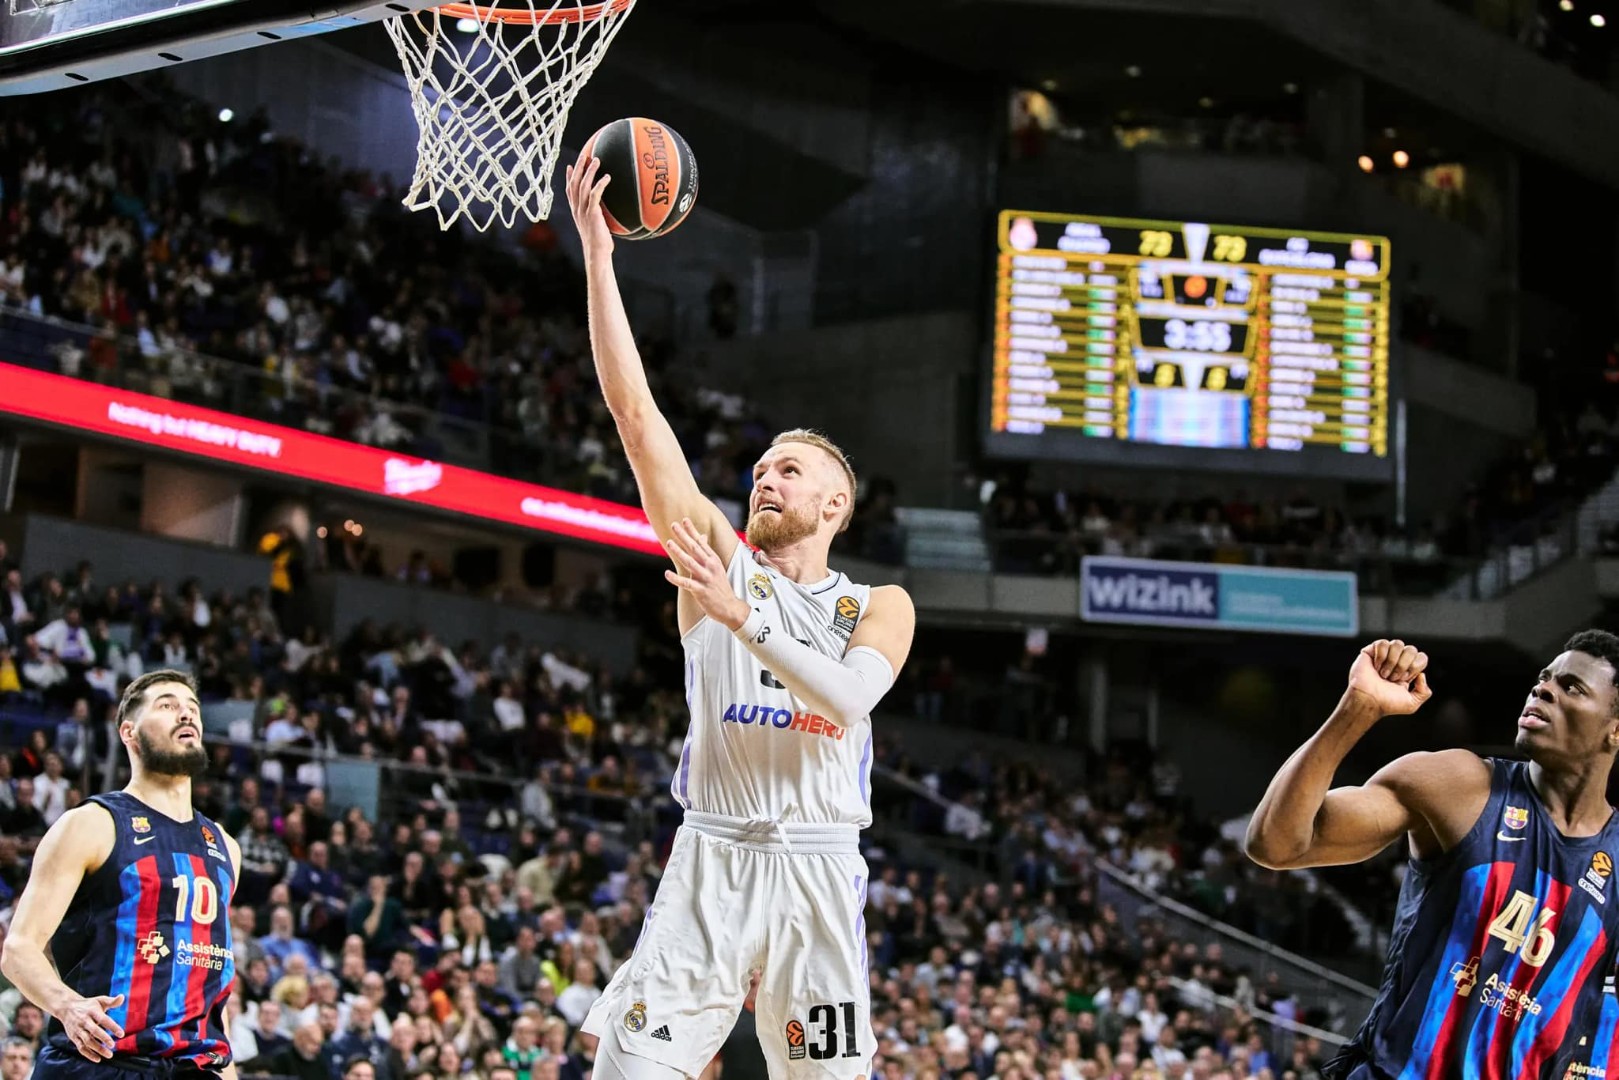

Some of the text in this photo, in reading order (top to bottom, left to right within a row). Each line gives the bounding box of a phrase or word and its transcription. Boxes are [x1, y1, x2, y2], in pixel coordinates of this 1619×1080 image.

[644, 126, 669, 205] SPALDING
[723, 703, 845, 741] AUTOHERO
[172, 874, 218, 925] 10
[1488, 889, 1557, 968] 46
[808, 1001, 861, 1060] 31
